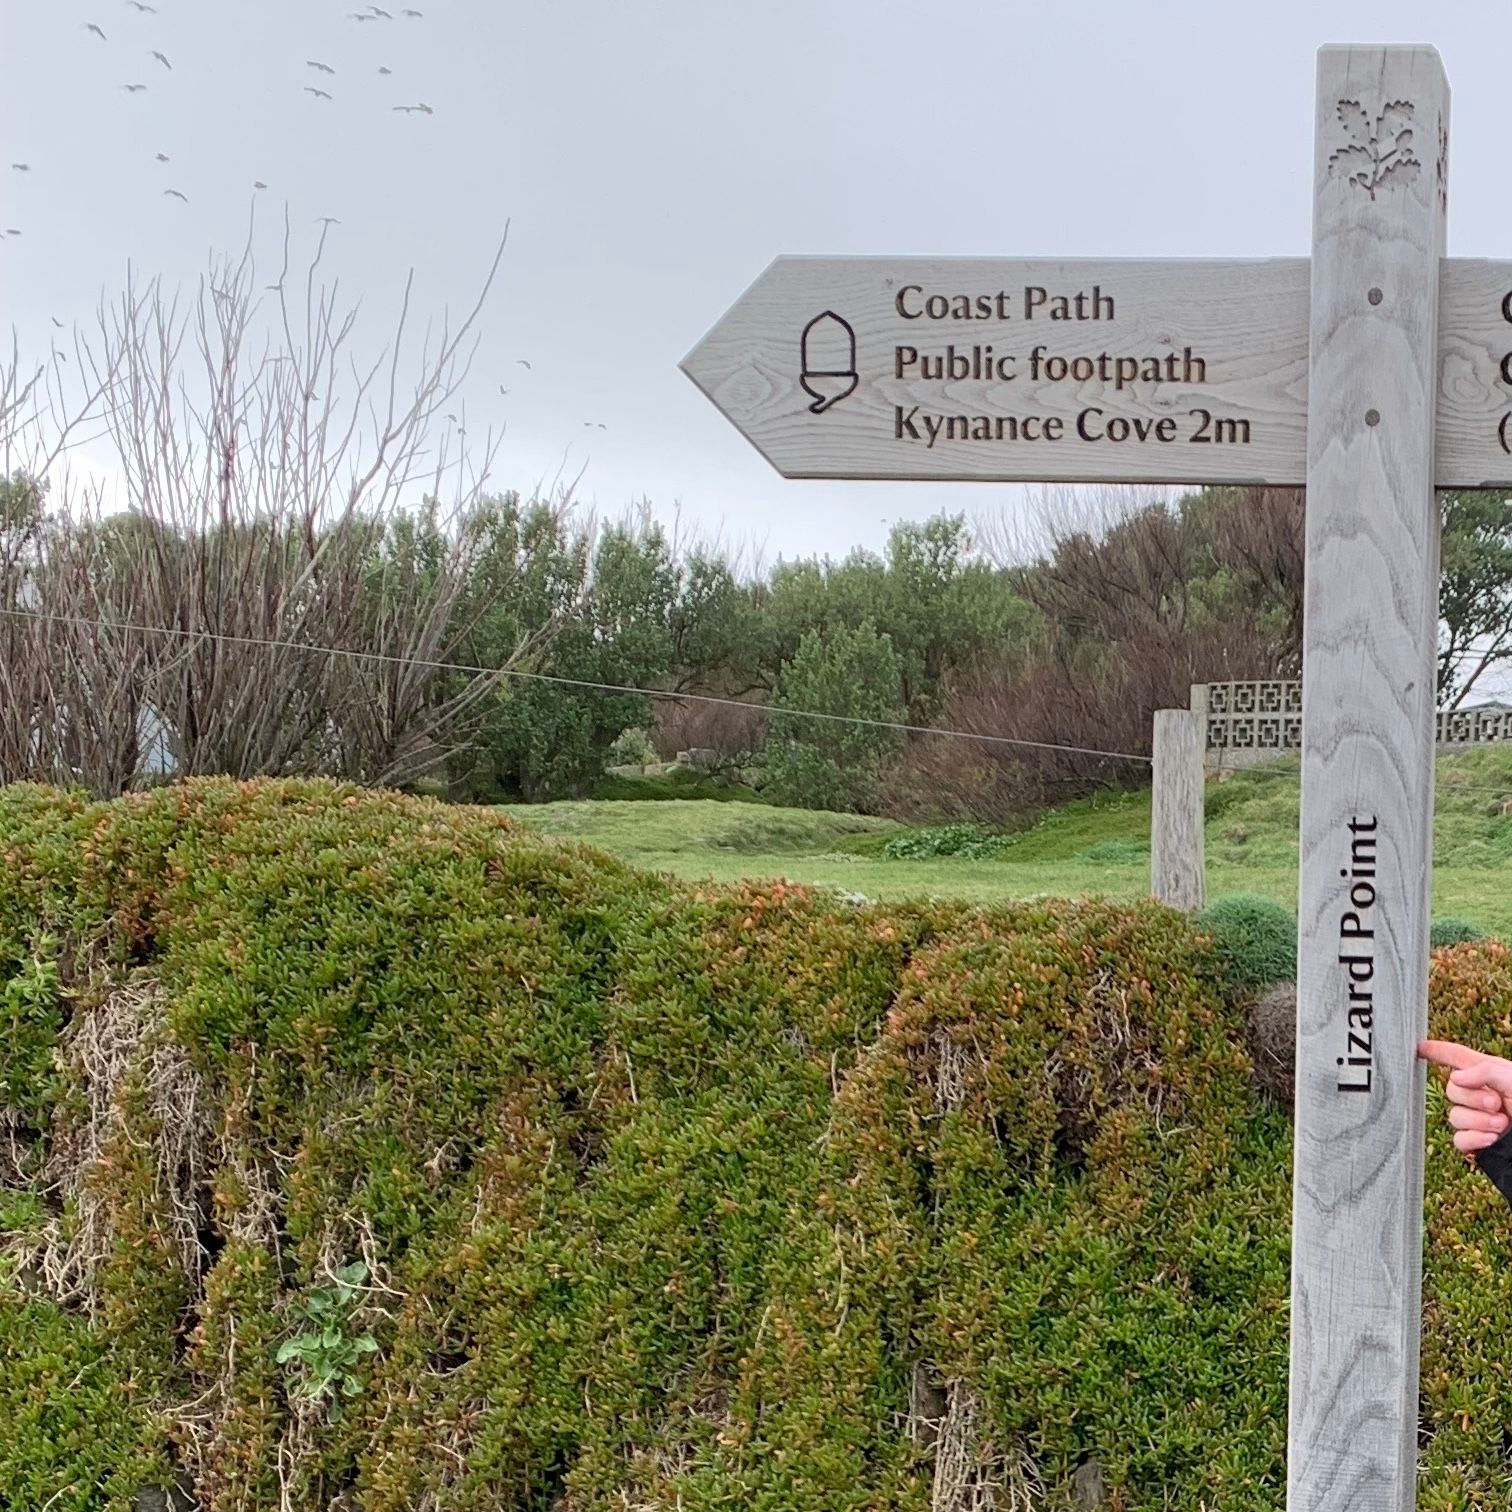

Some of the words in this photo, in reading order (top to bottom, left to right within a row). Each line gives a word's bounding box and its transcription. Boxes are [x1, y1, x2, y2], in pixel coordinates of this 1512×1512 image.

[895, 285, 1011, 321] Coast
[1024, 285, 1115, 321] Path
[895, 345, 1017, 381] Public
[1028, 345, 1206, 391] footpath
[895, 405, 1064, 449] Kynance
[1076, 407, 1177, 443] Cove
[1188, 408, 1250, 444] 2m
[1340, 815, 1378, 939] Point
[1336, 955, 1374, 1093] Lizard
